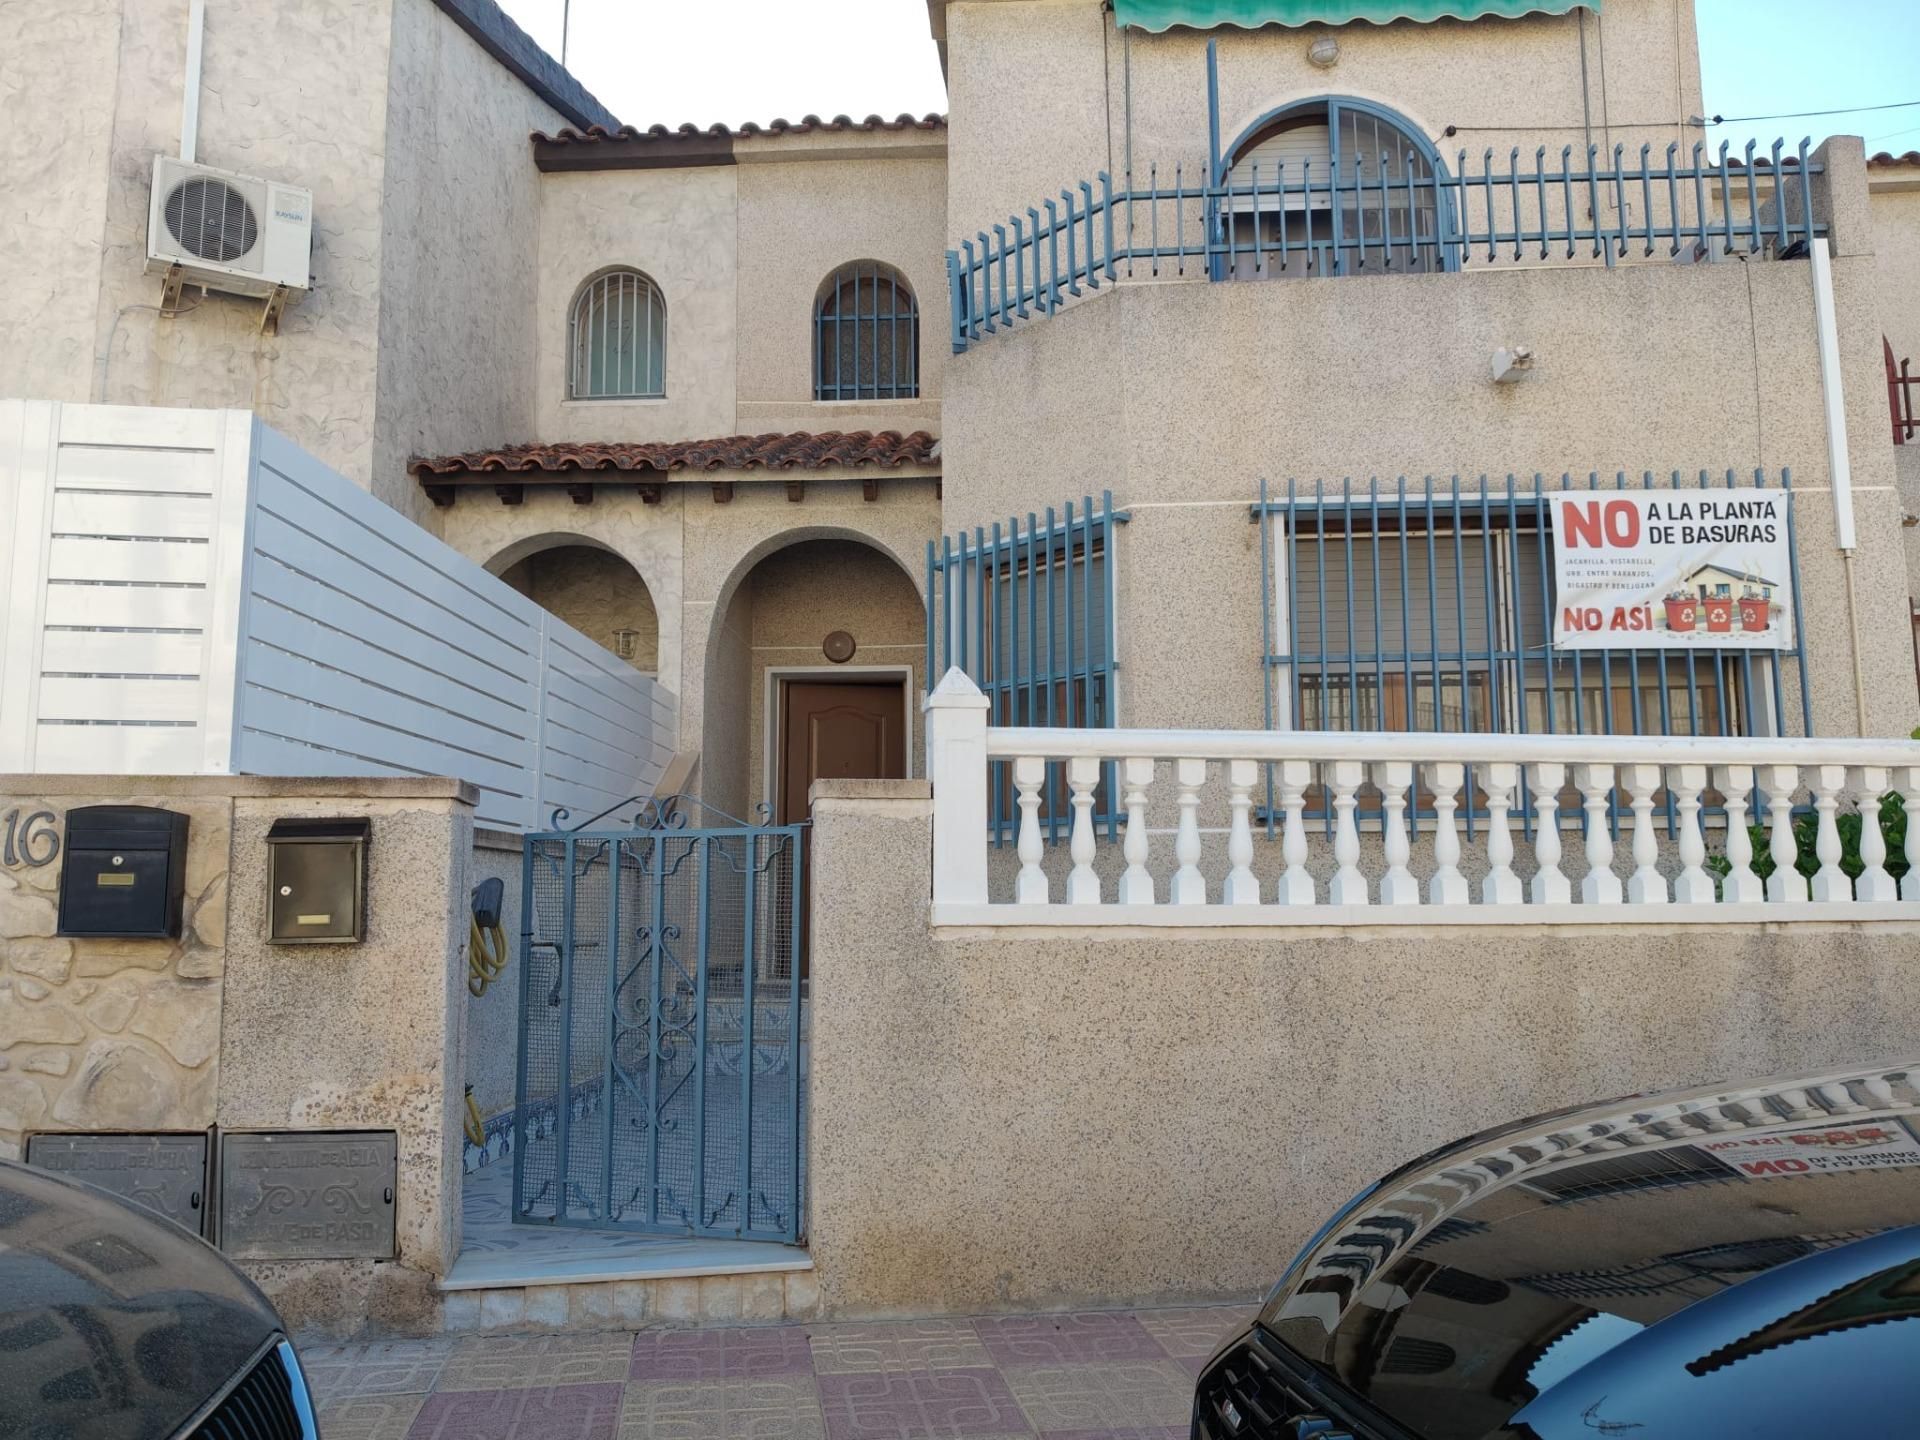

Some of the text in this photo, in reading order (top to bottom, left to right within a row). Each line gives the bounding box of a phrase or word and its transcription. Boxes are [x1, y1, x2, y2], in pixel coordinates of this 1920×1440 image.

[1562, 499, 1640, 548] NO
[1647, 501, 1777, 521] A LA PLANTA
[1649, 524, 1777, 544] DE BASURAS
[1564, 601, 1653, 632] NO ASÍ
[4, 809, 60, 867] 16
